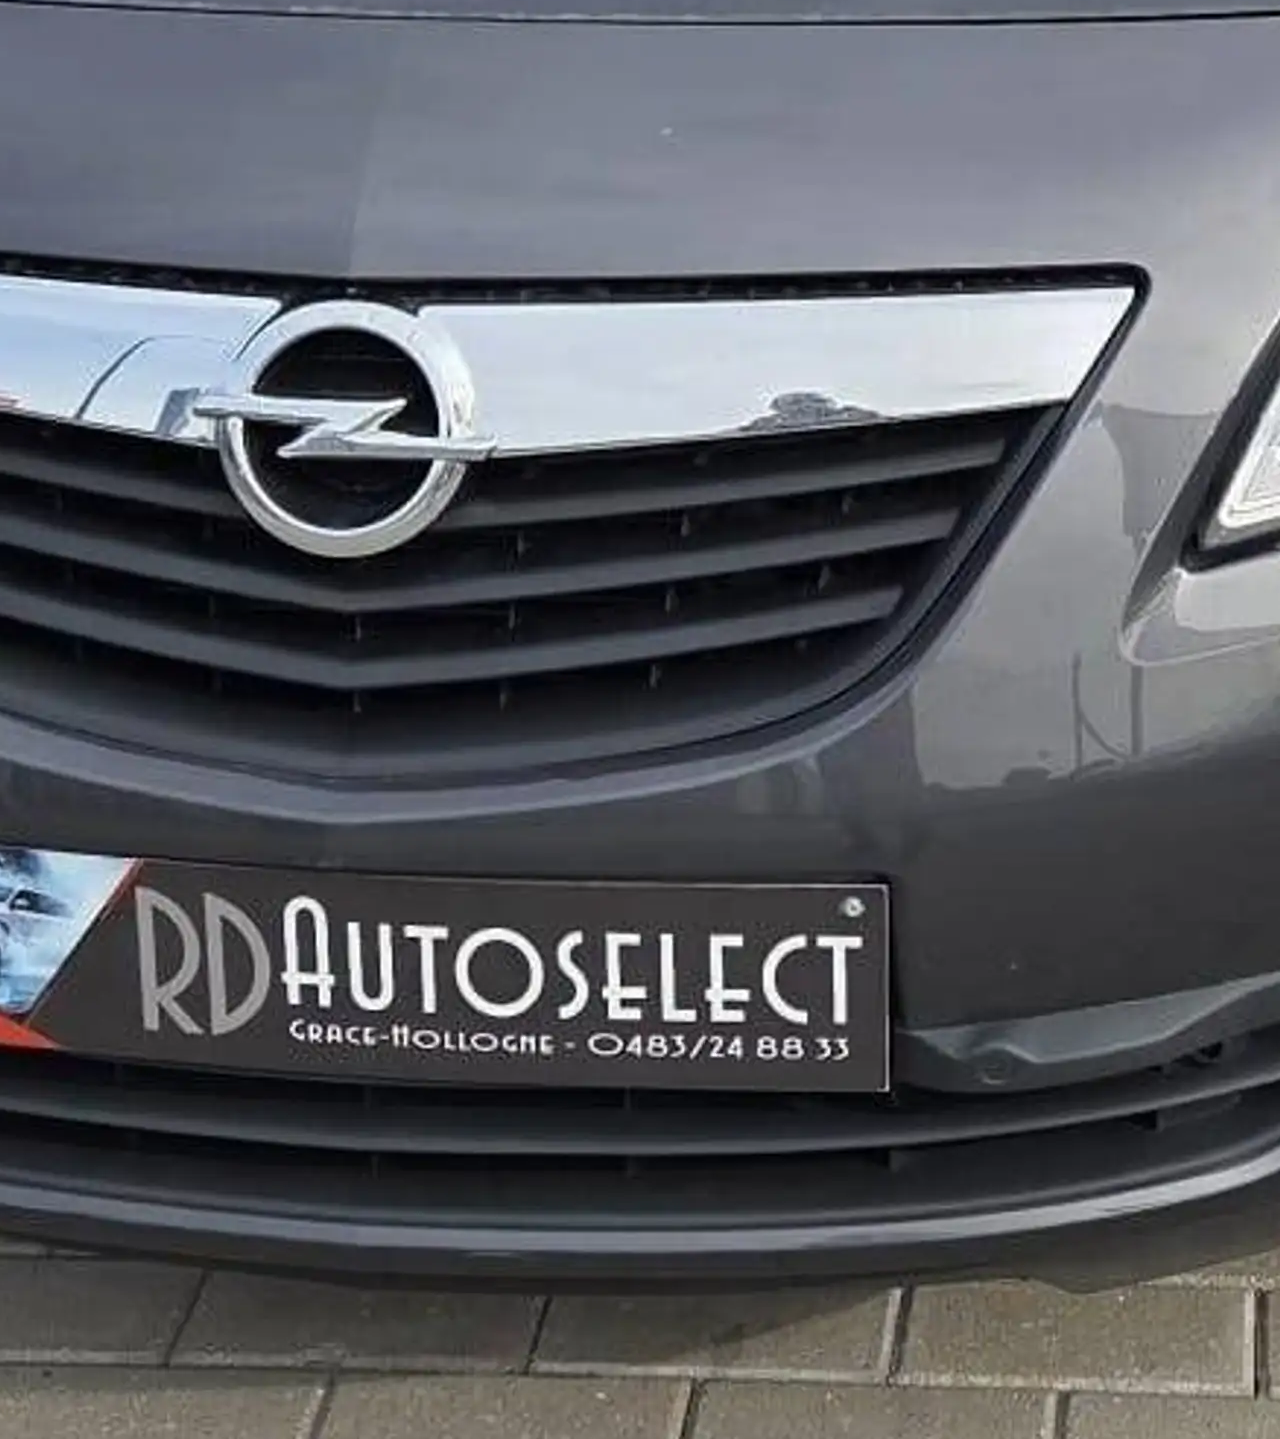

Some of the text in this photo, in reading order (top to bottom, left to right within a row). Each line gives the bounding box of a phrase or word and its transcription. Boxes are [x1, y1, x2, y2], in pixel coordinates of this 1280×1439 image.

[586, 1032, 743, 1060] 0483/24
[755, 1035, 805, 1060] 88
[816, 1037, 850, 1061] 33
